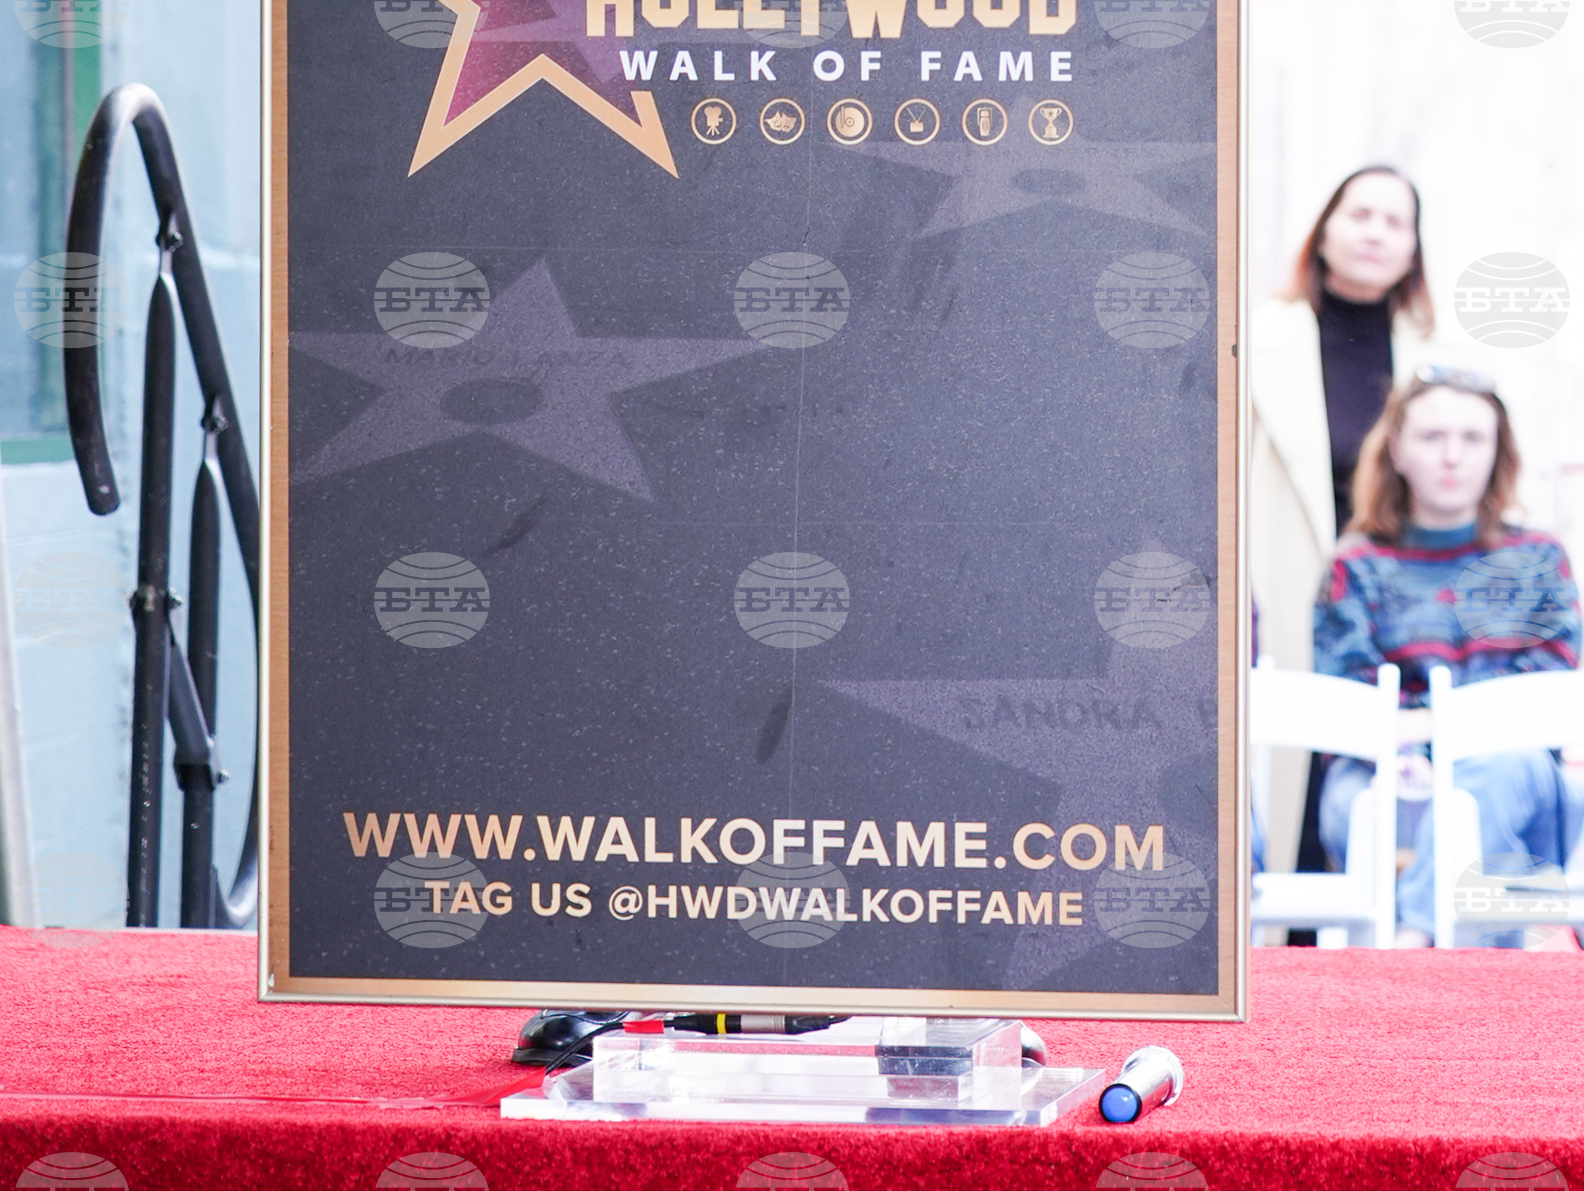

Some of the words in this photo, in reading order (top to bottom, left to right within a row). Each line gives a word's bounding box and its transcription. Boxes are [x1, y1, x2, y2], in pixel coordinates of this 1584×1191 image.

[618, 50, 777, 81] WALK
[812, 50, 882, 82] OF
[920, 50, 1073, 82] FAME
[343, 812, 1165, 872] WWW.WALKOFFAME.COM
[424, 880, 513, 915] TAG
[531, 882, 592, 917] US
[608, 884, 1083, 926] @HWDWALKOFFAME
